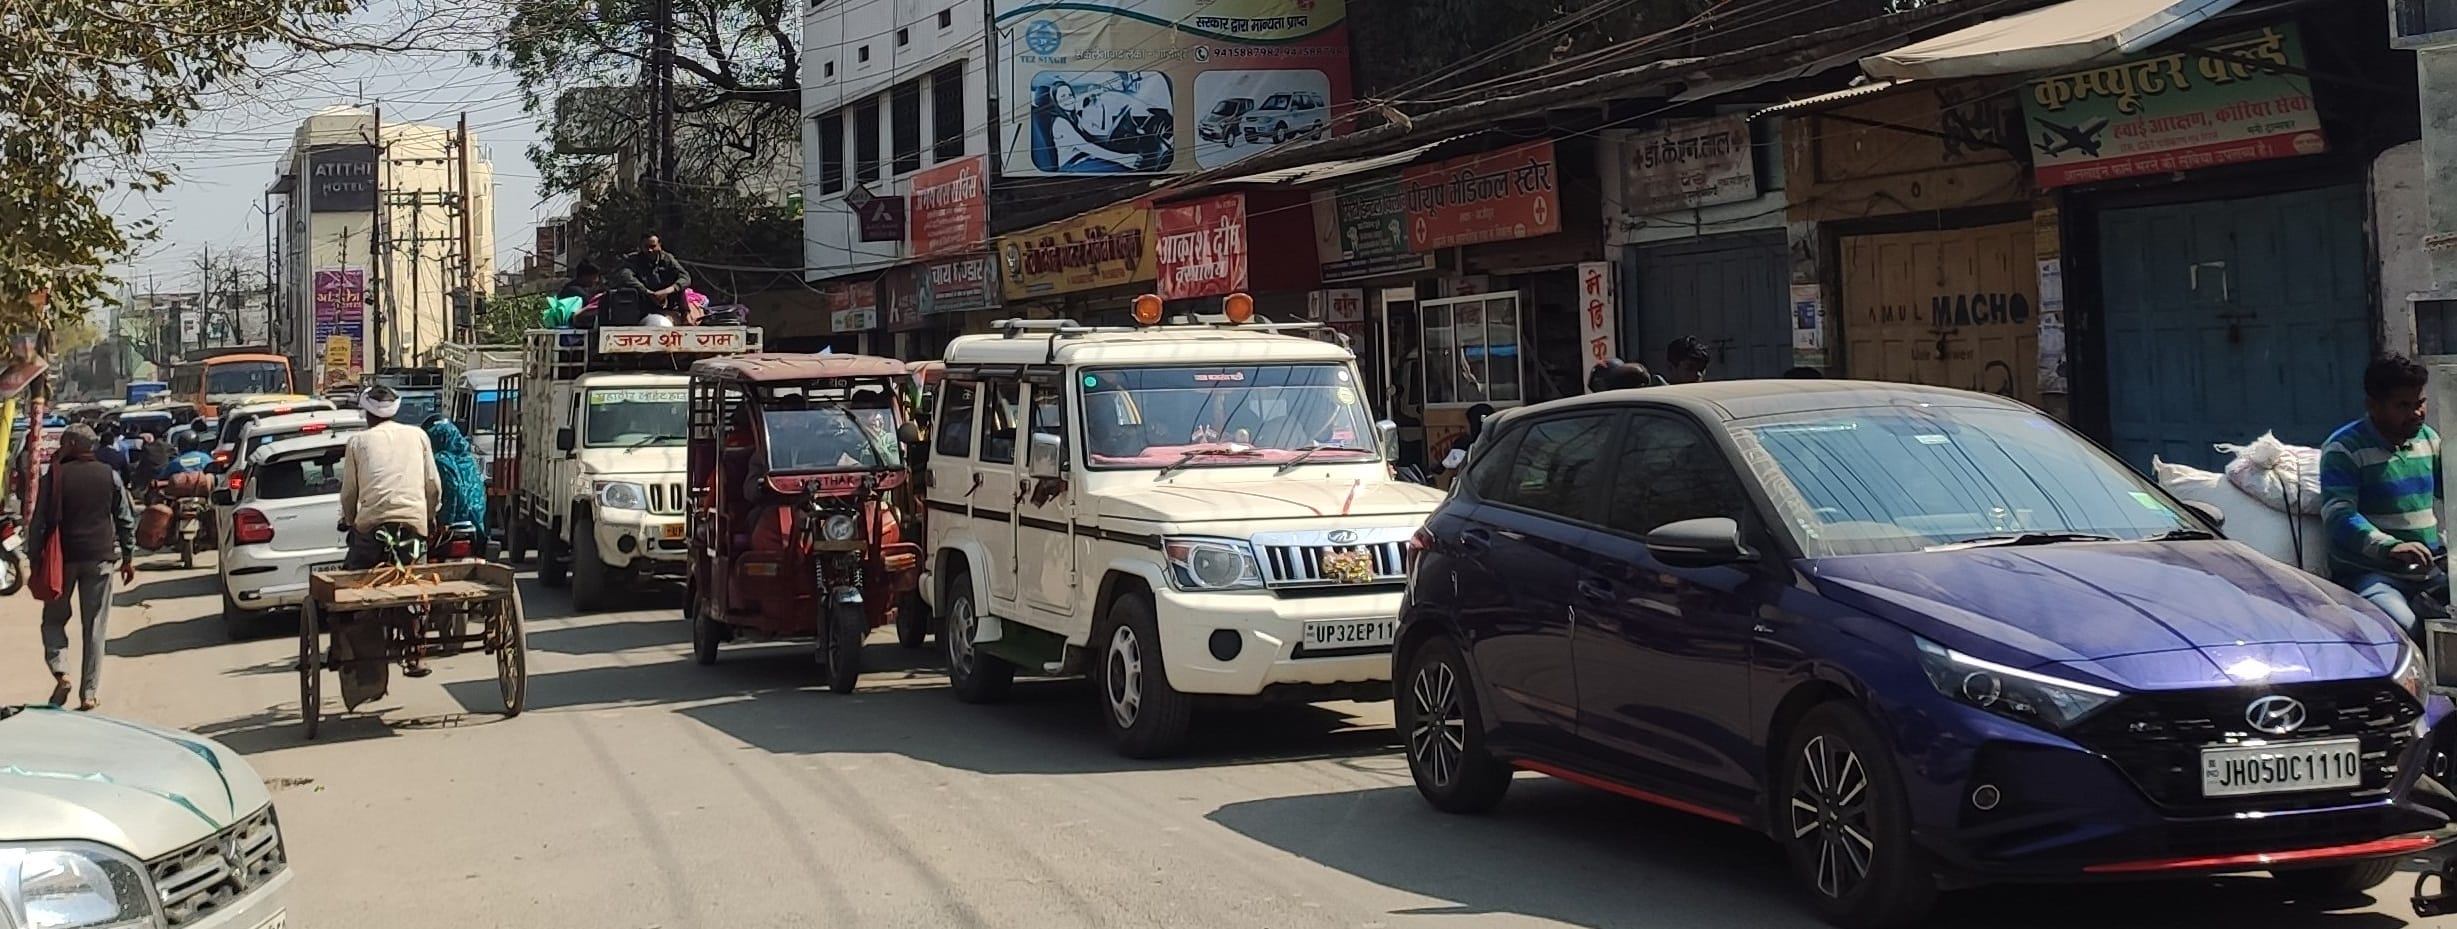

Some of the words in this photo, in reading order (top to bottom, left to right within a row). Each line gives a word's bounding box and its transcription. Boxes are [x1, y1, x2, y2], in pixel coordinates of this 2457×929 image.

[1231, 18, 1249, 32] द्वारा
[1250, 17, 1285, 32] मान्यता
[1287, 15, 1308, 30] प्राप्त
[315, 162, 371, 176] ATITHI
[323, 182, 364, 197] HOTEL
[1449, 170, 1510, 205] मेडिकल
[1513, 157, 1553, 195] स्टोर
[1585, 269, 1608, 366] मेडिक
[1932, 292, 2030, 327] MACHO
[613, 334, 653, 347] जय
[658, 331, 683, 348] श्री
[695, 333, 734, 346] राम
[1317, 621, 1393, 643] UP32EP11
[2220, 752, 2356, 786] JH05DC1110
